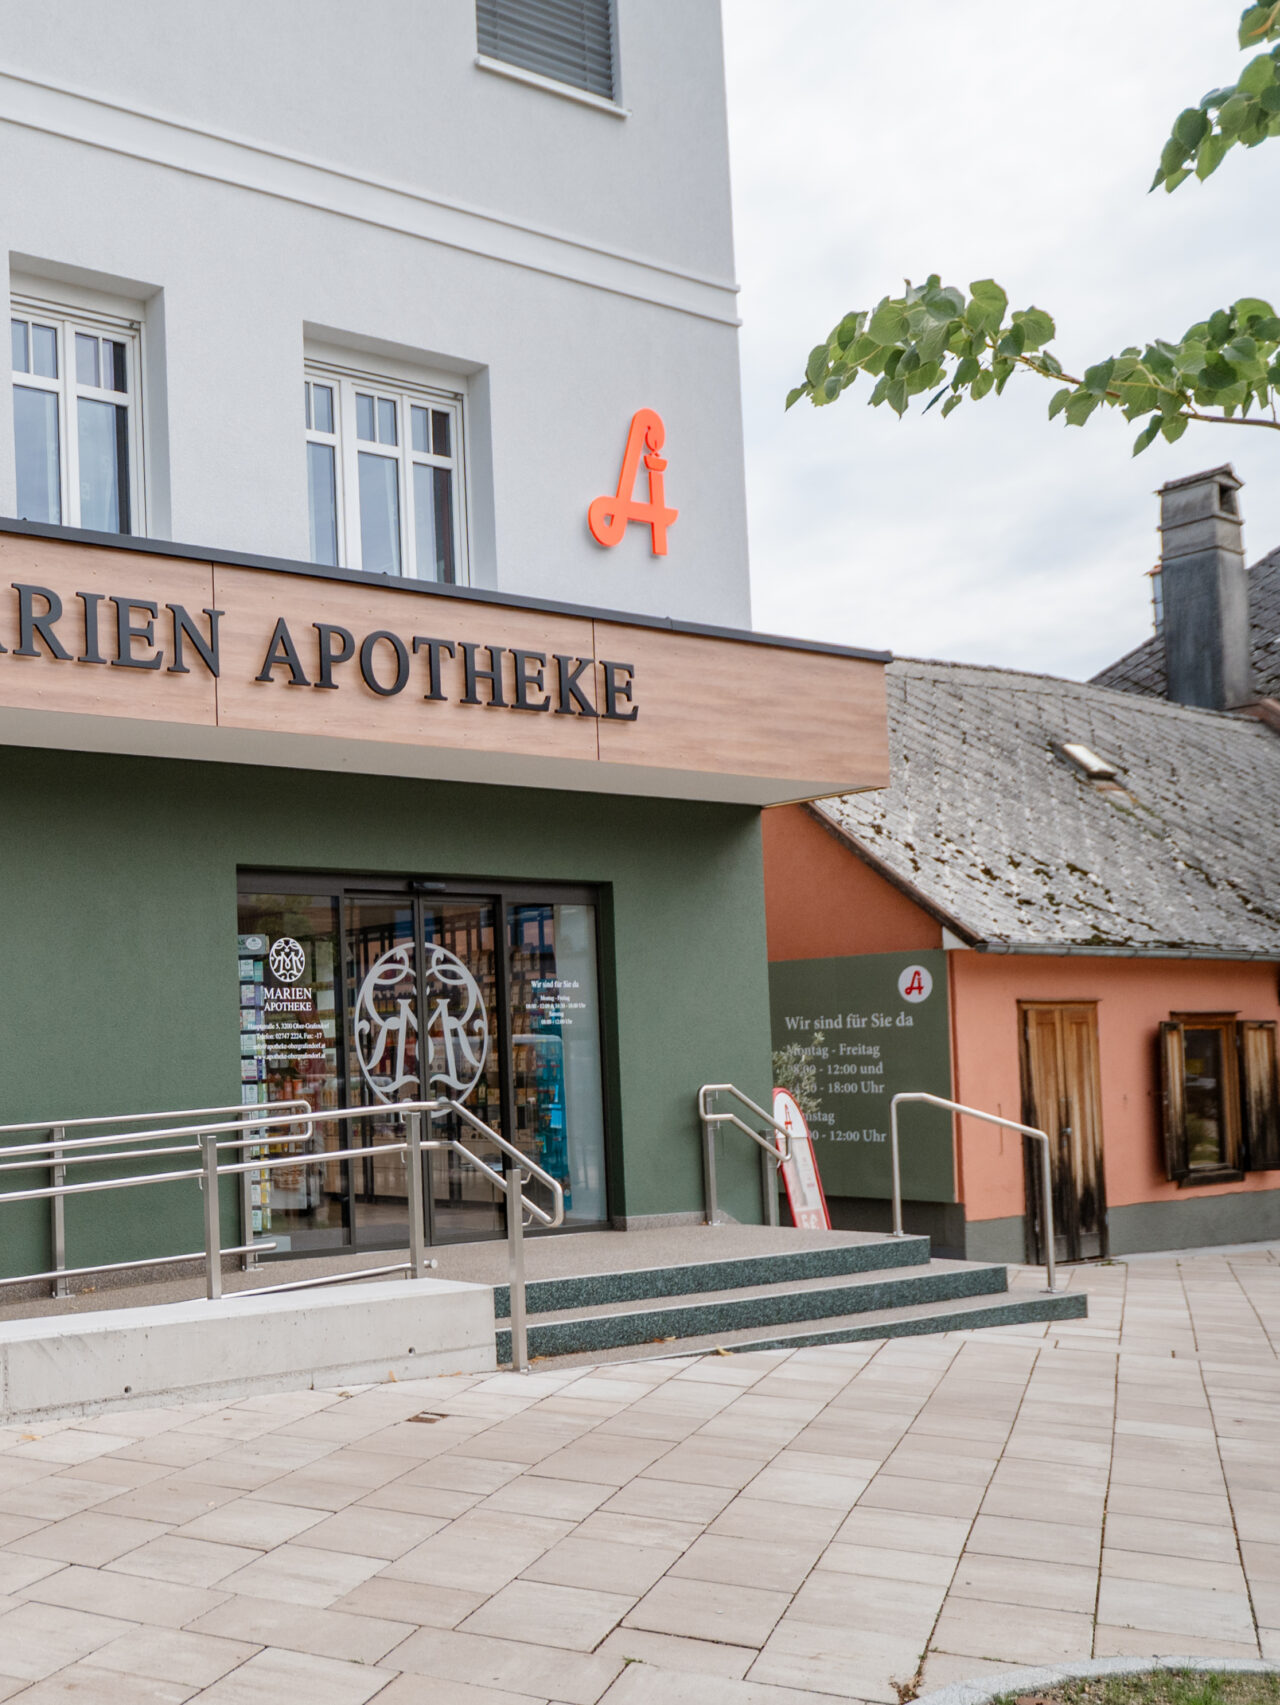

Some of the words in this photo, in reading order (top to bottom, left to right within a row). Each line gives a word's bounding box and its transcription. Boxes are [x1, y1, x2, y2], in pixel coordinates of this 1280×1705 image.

[254, 617, 639, 721] APOTHEKE
[264, 988, 312, 999] MARIEN
[264, 1002, 312, 1011] APOTHEKE
[785, 1016, 810, 1030] Wir
[814, 1014, 842, 1029] sind
[846, 1013, 868, 1028] für
[871, 1013, 892, 1028] Sie
[896, 1011, 914, 1027] da
[839, 1043, 881, 1059] Freitag
[827, 1064, 857, 1075] 12:00
[860, 1061, 884, 1075] und
[828, 1082, 858, 1094] 18:00
[861, 1081, 885, 1094] Uhr
[830, 1130, 860, 1142] 12:00
[863, 1129, 887, 1142] Uhr
